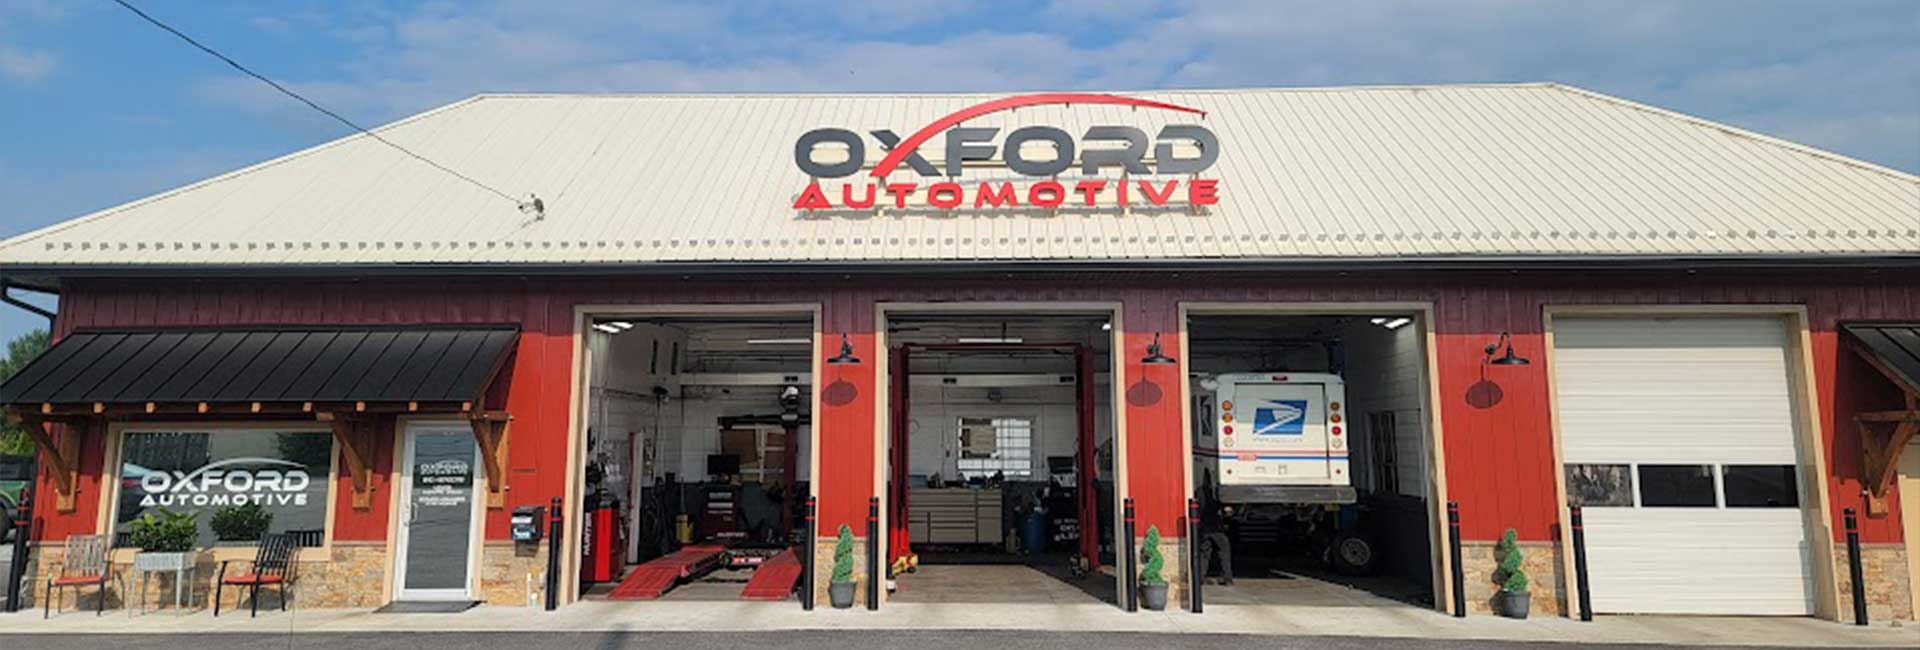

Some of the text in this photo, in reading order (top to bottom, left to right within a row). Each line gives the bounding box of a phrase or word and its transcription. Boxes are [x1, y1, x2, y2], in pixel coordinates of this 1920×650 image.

[795, 125, 1219, 178] OXFORD
[792, 179, 1220, 209] AUTOMOTIVE
[141, 470, 310, 493] OXFORD
[139, 494, 308, 507] AUTOMOTIVE
[583, 511, 592, 556] HUNTER
